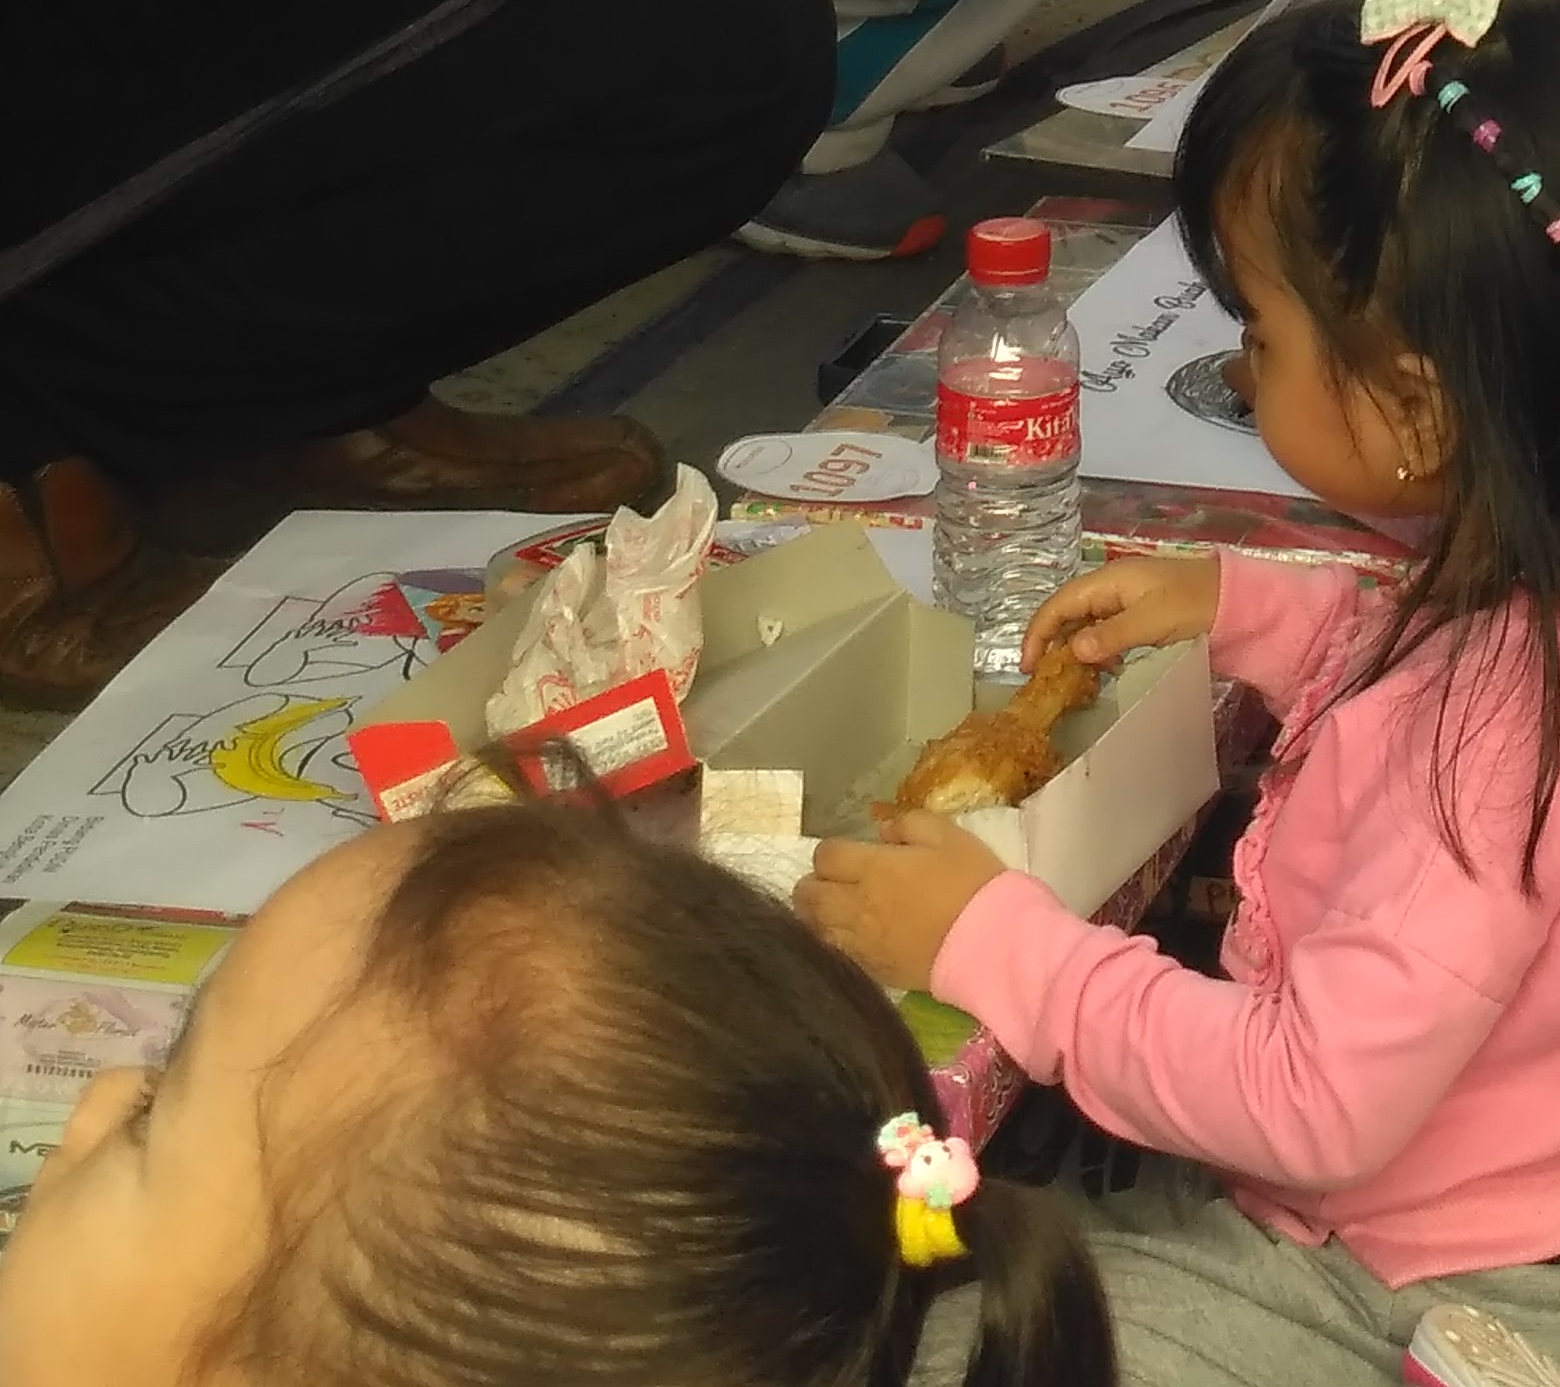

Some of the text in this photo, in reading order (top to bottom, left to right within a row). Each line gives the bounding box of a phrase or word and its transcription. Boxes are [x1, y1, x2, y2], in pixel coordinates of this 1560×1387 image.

[1079, 359, 1136, 393] Ayo
[1109, 313, 1180, 358] Makan
[788, 442, 884, 497] 1097
